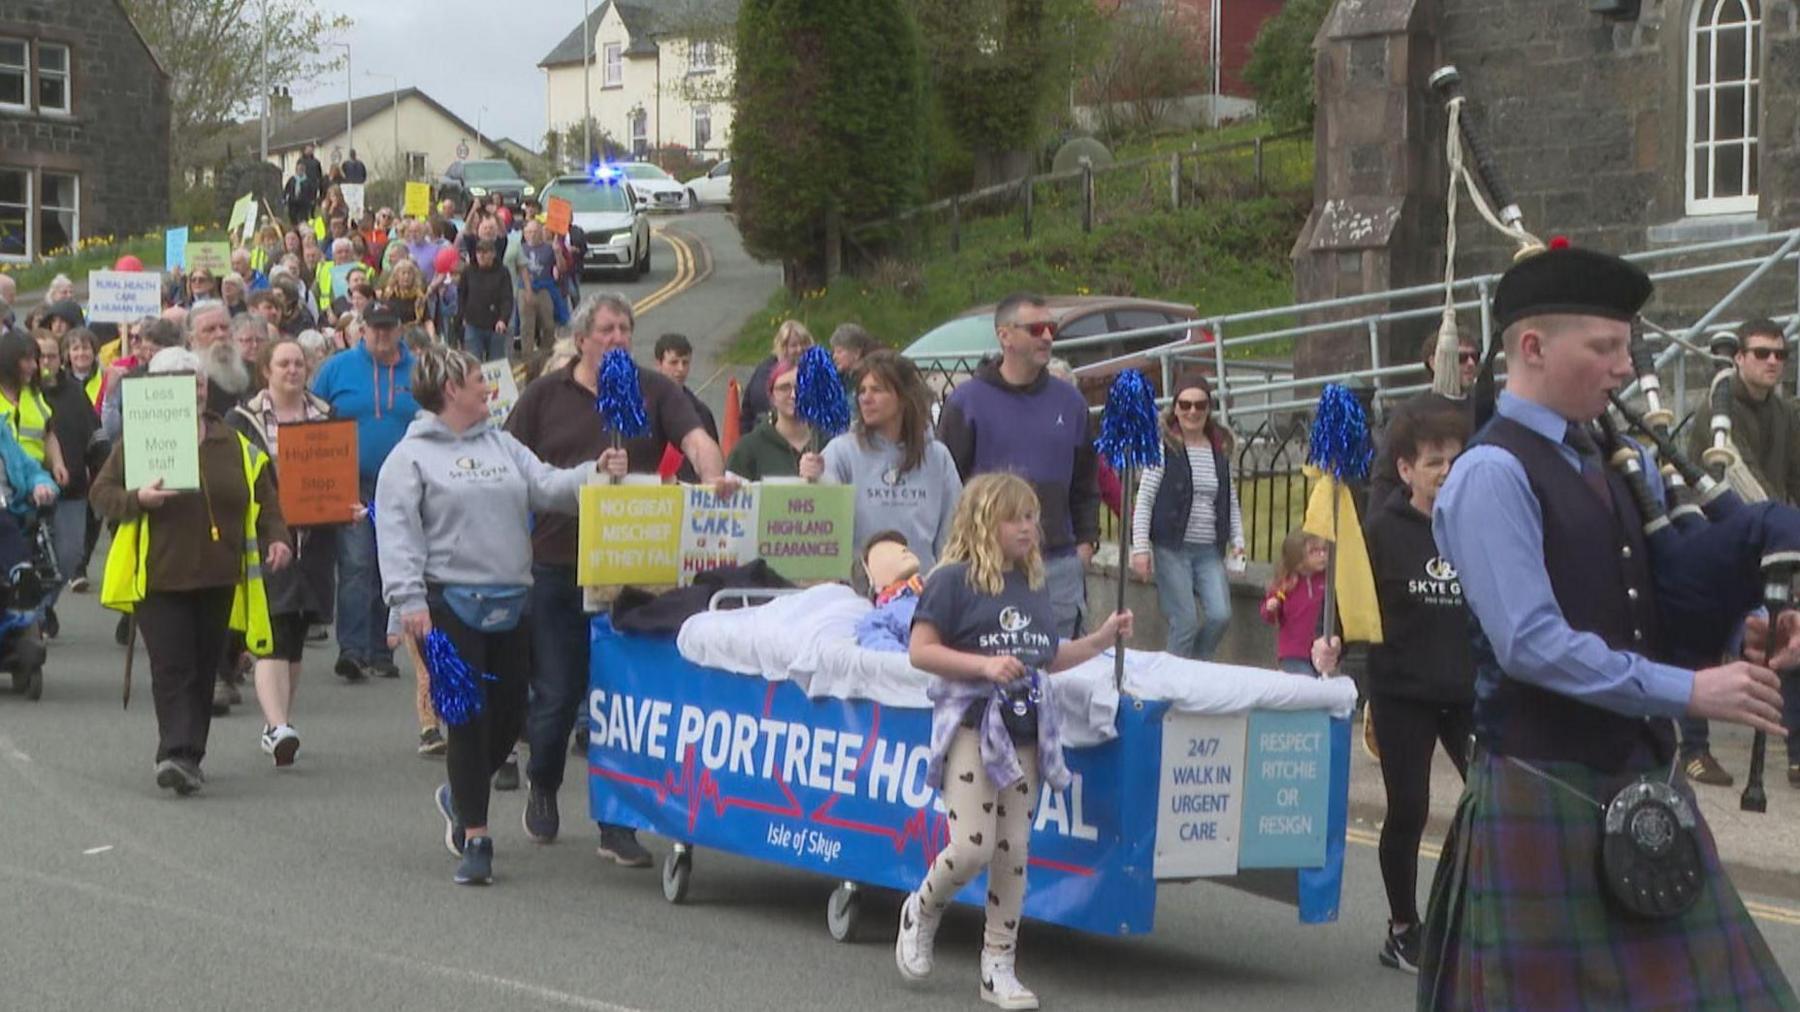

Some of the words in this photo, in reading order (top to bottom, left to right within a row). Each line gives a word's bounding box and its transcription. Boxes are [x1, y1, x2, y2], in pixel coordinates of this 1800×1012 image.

[124, 280, 156, 290] HEALTH
[101, 304, 132, 313] HUMAN
[136, 305, 159, 314] RIGHT
[145, 387, 175, 400] Less
[129, 406, 191, 422] managers
[145, 437, 177, 451] More
[285, 444, 349, 463] Highland
[148, 457, 175, 470] staff
[302, 477, 336, 492] Stop
[867, 488, 898, 498] SKYE
[901, 488, 926, 498] GYM
[601, 500, 625, 514] NO
[629, 499, 672, 515] GREAT
[788, 499, 815, 513] NHS
[692, 511, 747, 537] CARE
[767, 520, 834, 535] HIGHLAND
[603, 524, 672, 541] MISCHIEF
[759, 541, 839, 557] CLEARANCES
[589, 550, 600, 567] IF
[605, 548, 644, 567] THEY
[1407, 580, 1446, 594] SKYE
[979, 632, 1018, 647] SKYE
[1023, 631, 1050, 646] GYM
[589, 689, 672, 759] SAVE
[675, 704, 863, 796] PORTREE
[1188, 738, 1220, 757] 24/7
[1260, 733, 1322, 752] RESPECT
[1173, 767, 1214, 784] WALK
[1217, 766, 1231, 784] IN
[1262, 762, 1316, 779] RITCHIE
[1171, 794, 1230, 814] URGENT
[1277, 788, 1299, 806] OR
[1179, 822, 1217, 841] CARE
[1259, 816, 1312, 835] RESIGN
[766, 822, 792, 848] Isle
[792, 826, 808, 855] of
[808, 828, 842, 862] Skye
